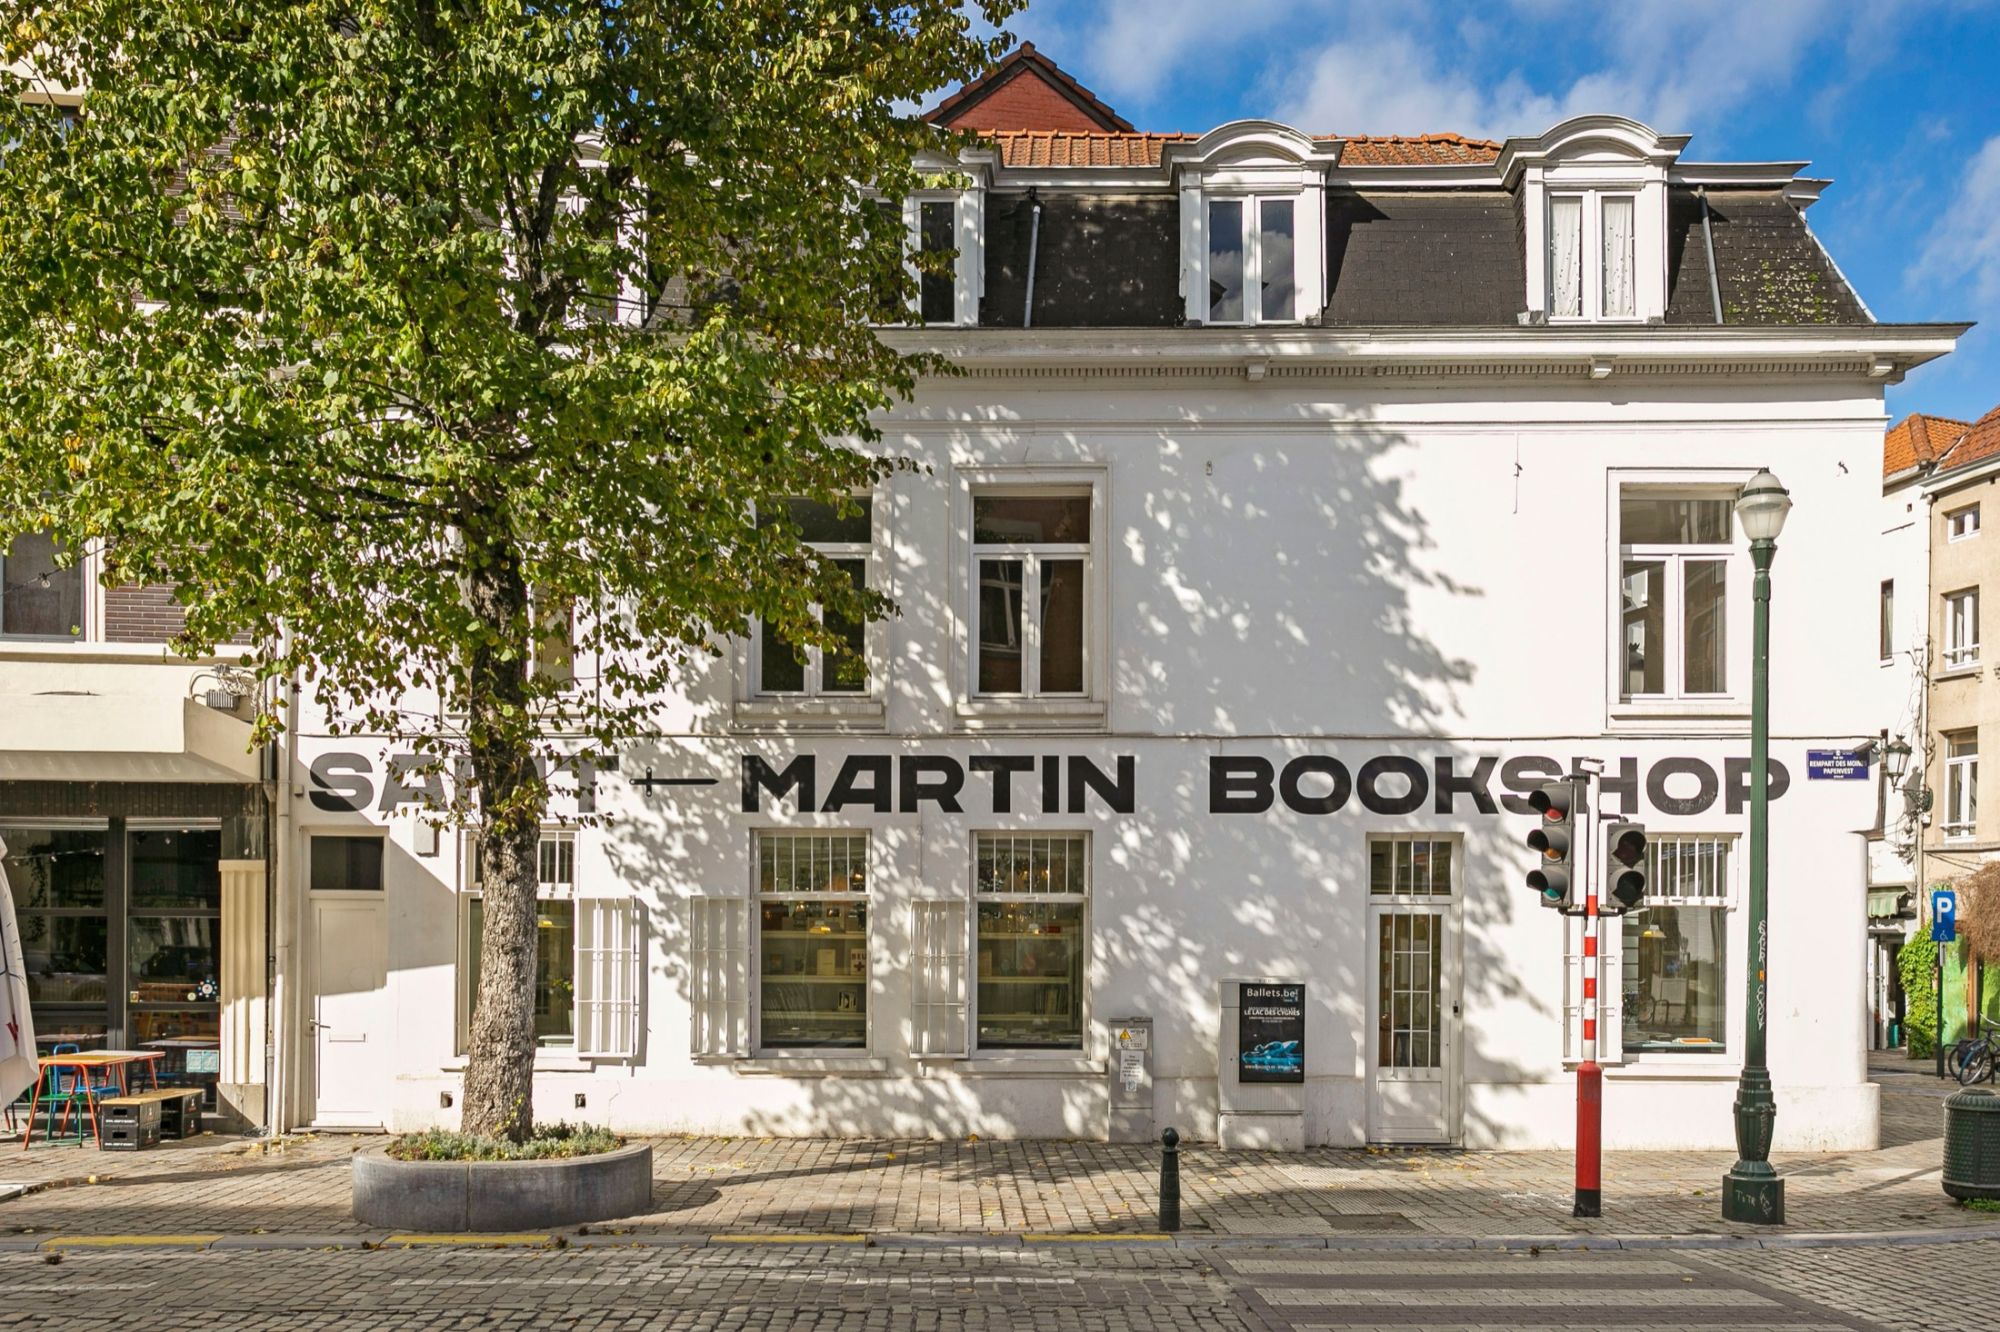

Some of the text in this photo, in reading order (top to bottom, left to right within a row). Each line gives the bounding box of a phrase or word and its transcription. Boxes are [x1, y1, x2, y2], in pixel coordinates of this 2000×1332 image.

[309, 752, 1790, 815] SAIT MARTIN BOOKSHOP
[1936, 897, 1953, 923] P
